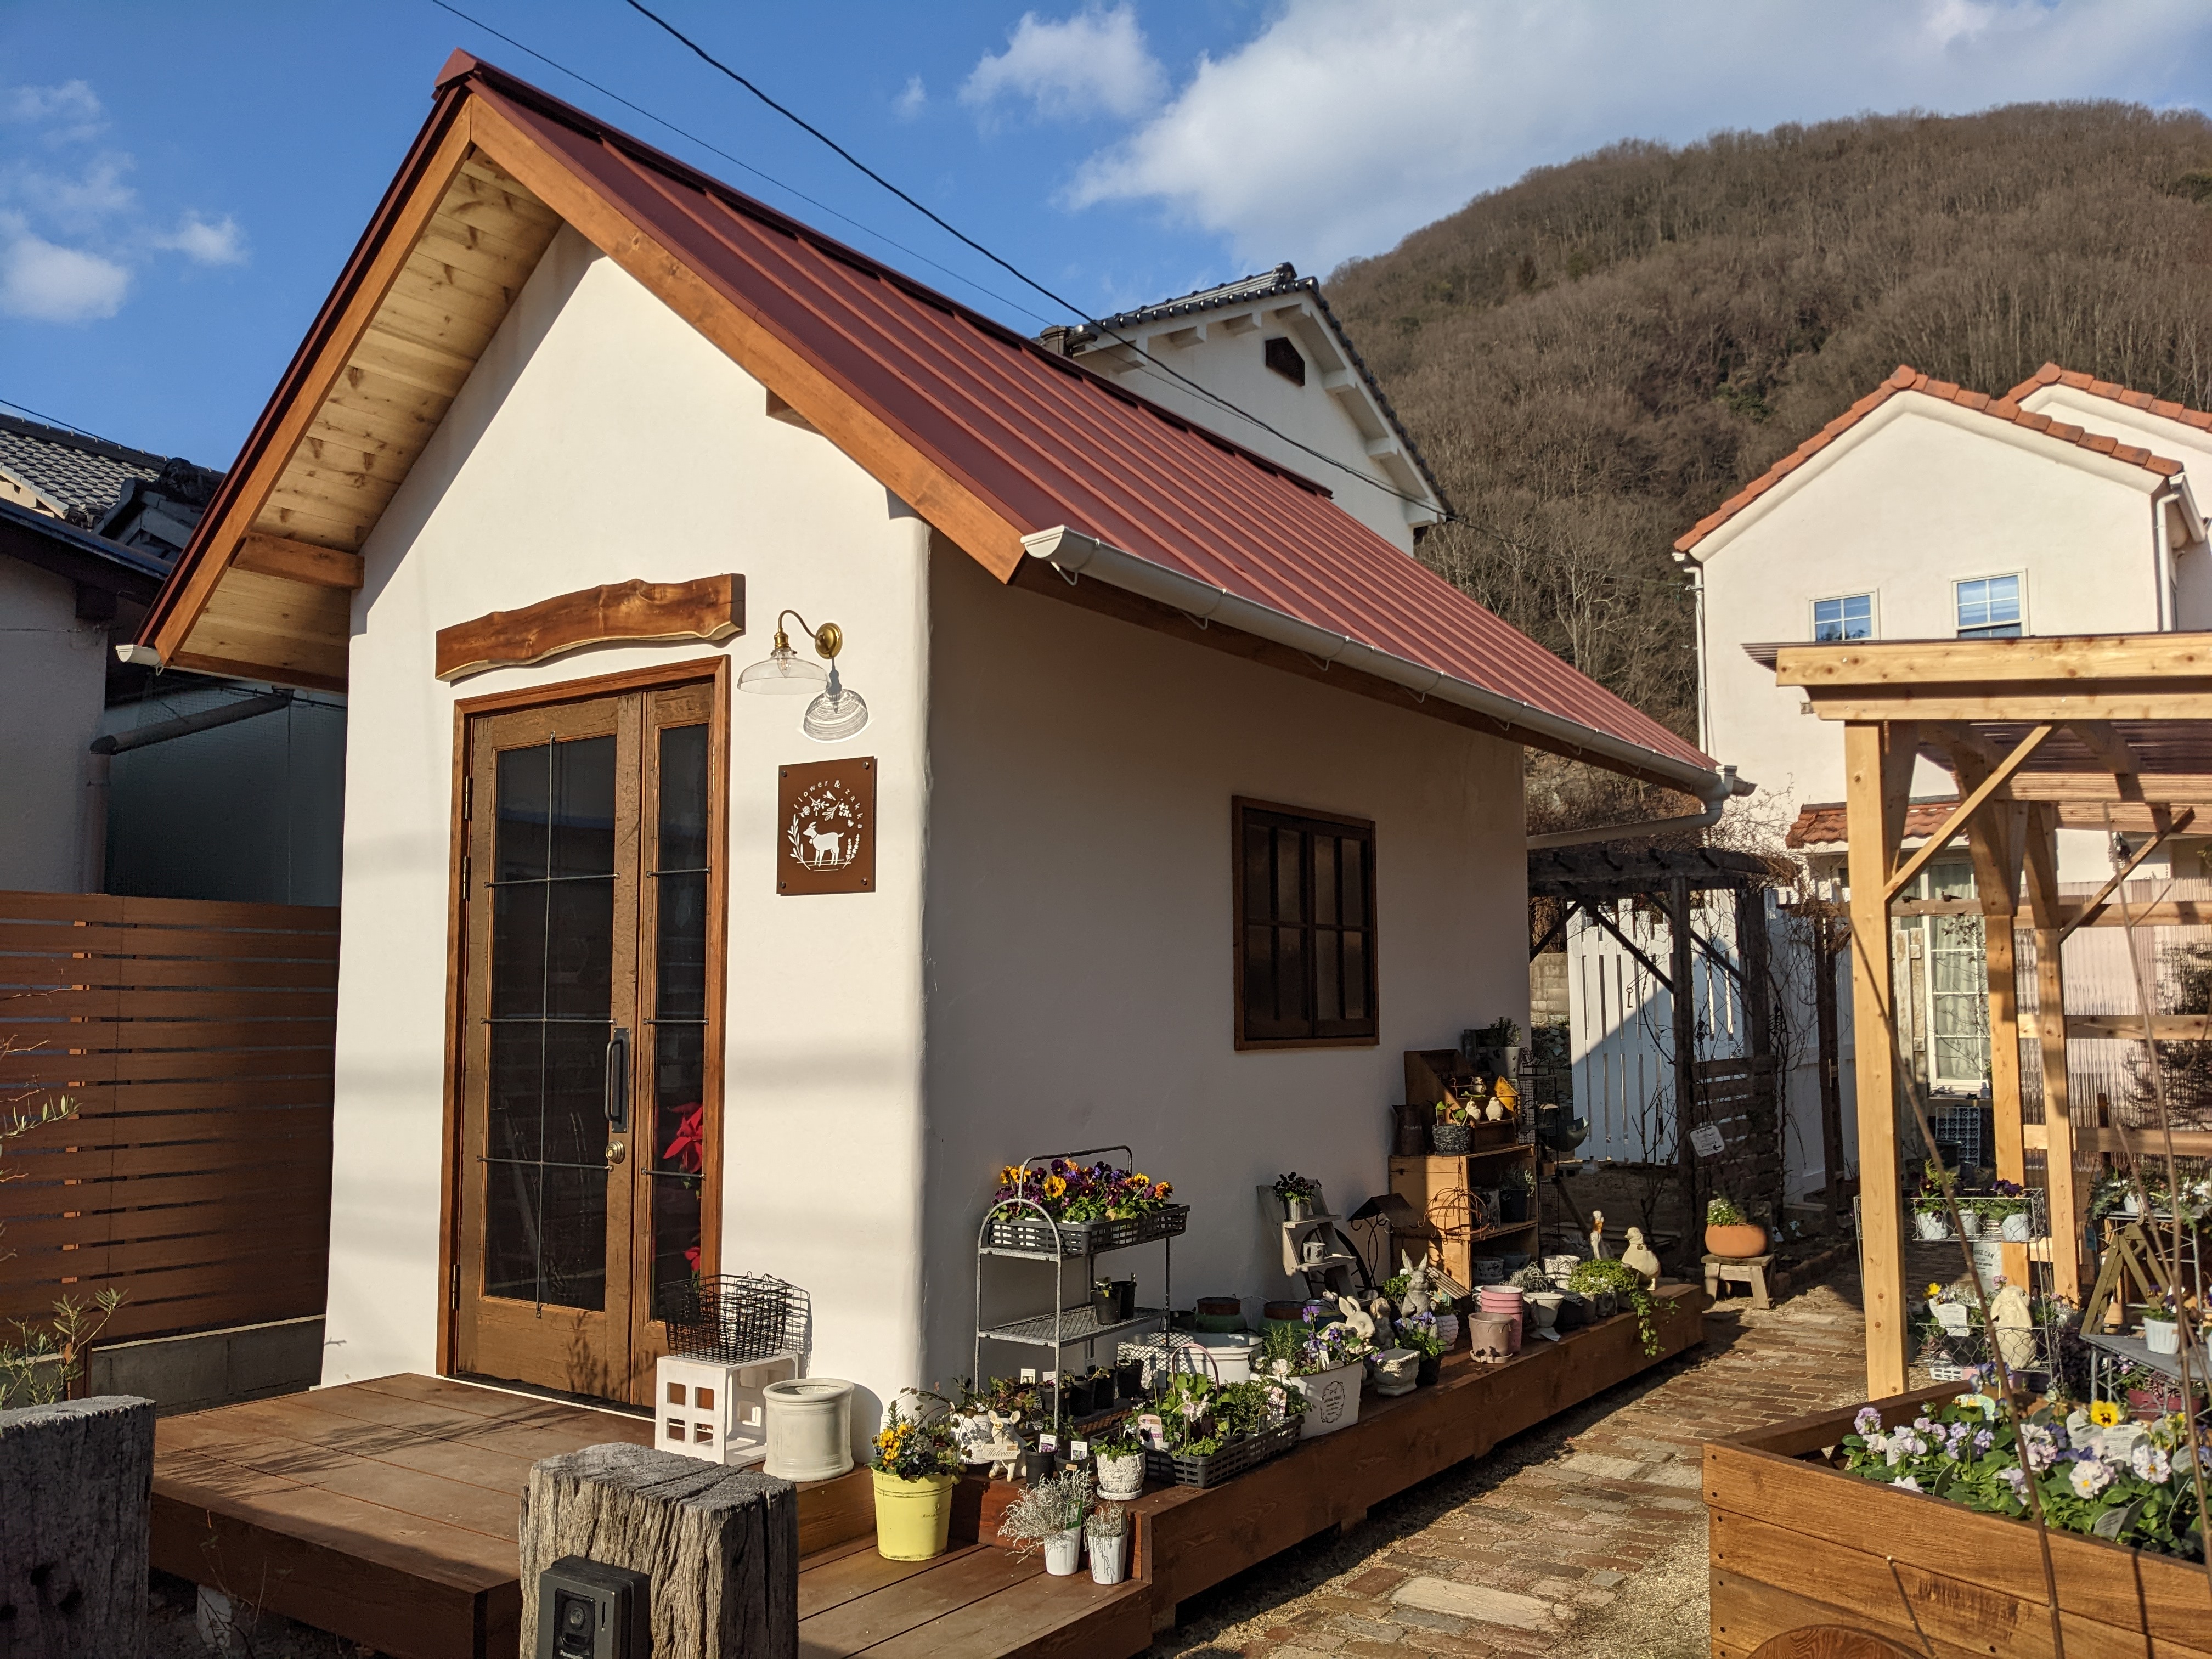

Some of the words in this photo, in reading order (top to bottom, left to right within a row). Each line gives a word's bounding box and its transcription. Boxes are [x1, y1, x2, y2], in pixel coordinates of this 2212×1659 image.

[793, 781, 828, 810] flower
[834, 780, 840, 789] &
[845, 788, 864, 829] zakka
[987, 1447, 1015, 1457] Welcome
